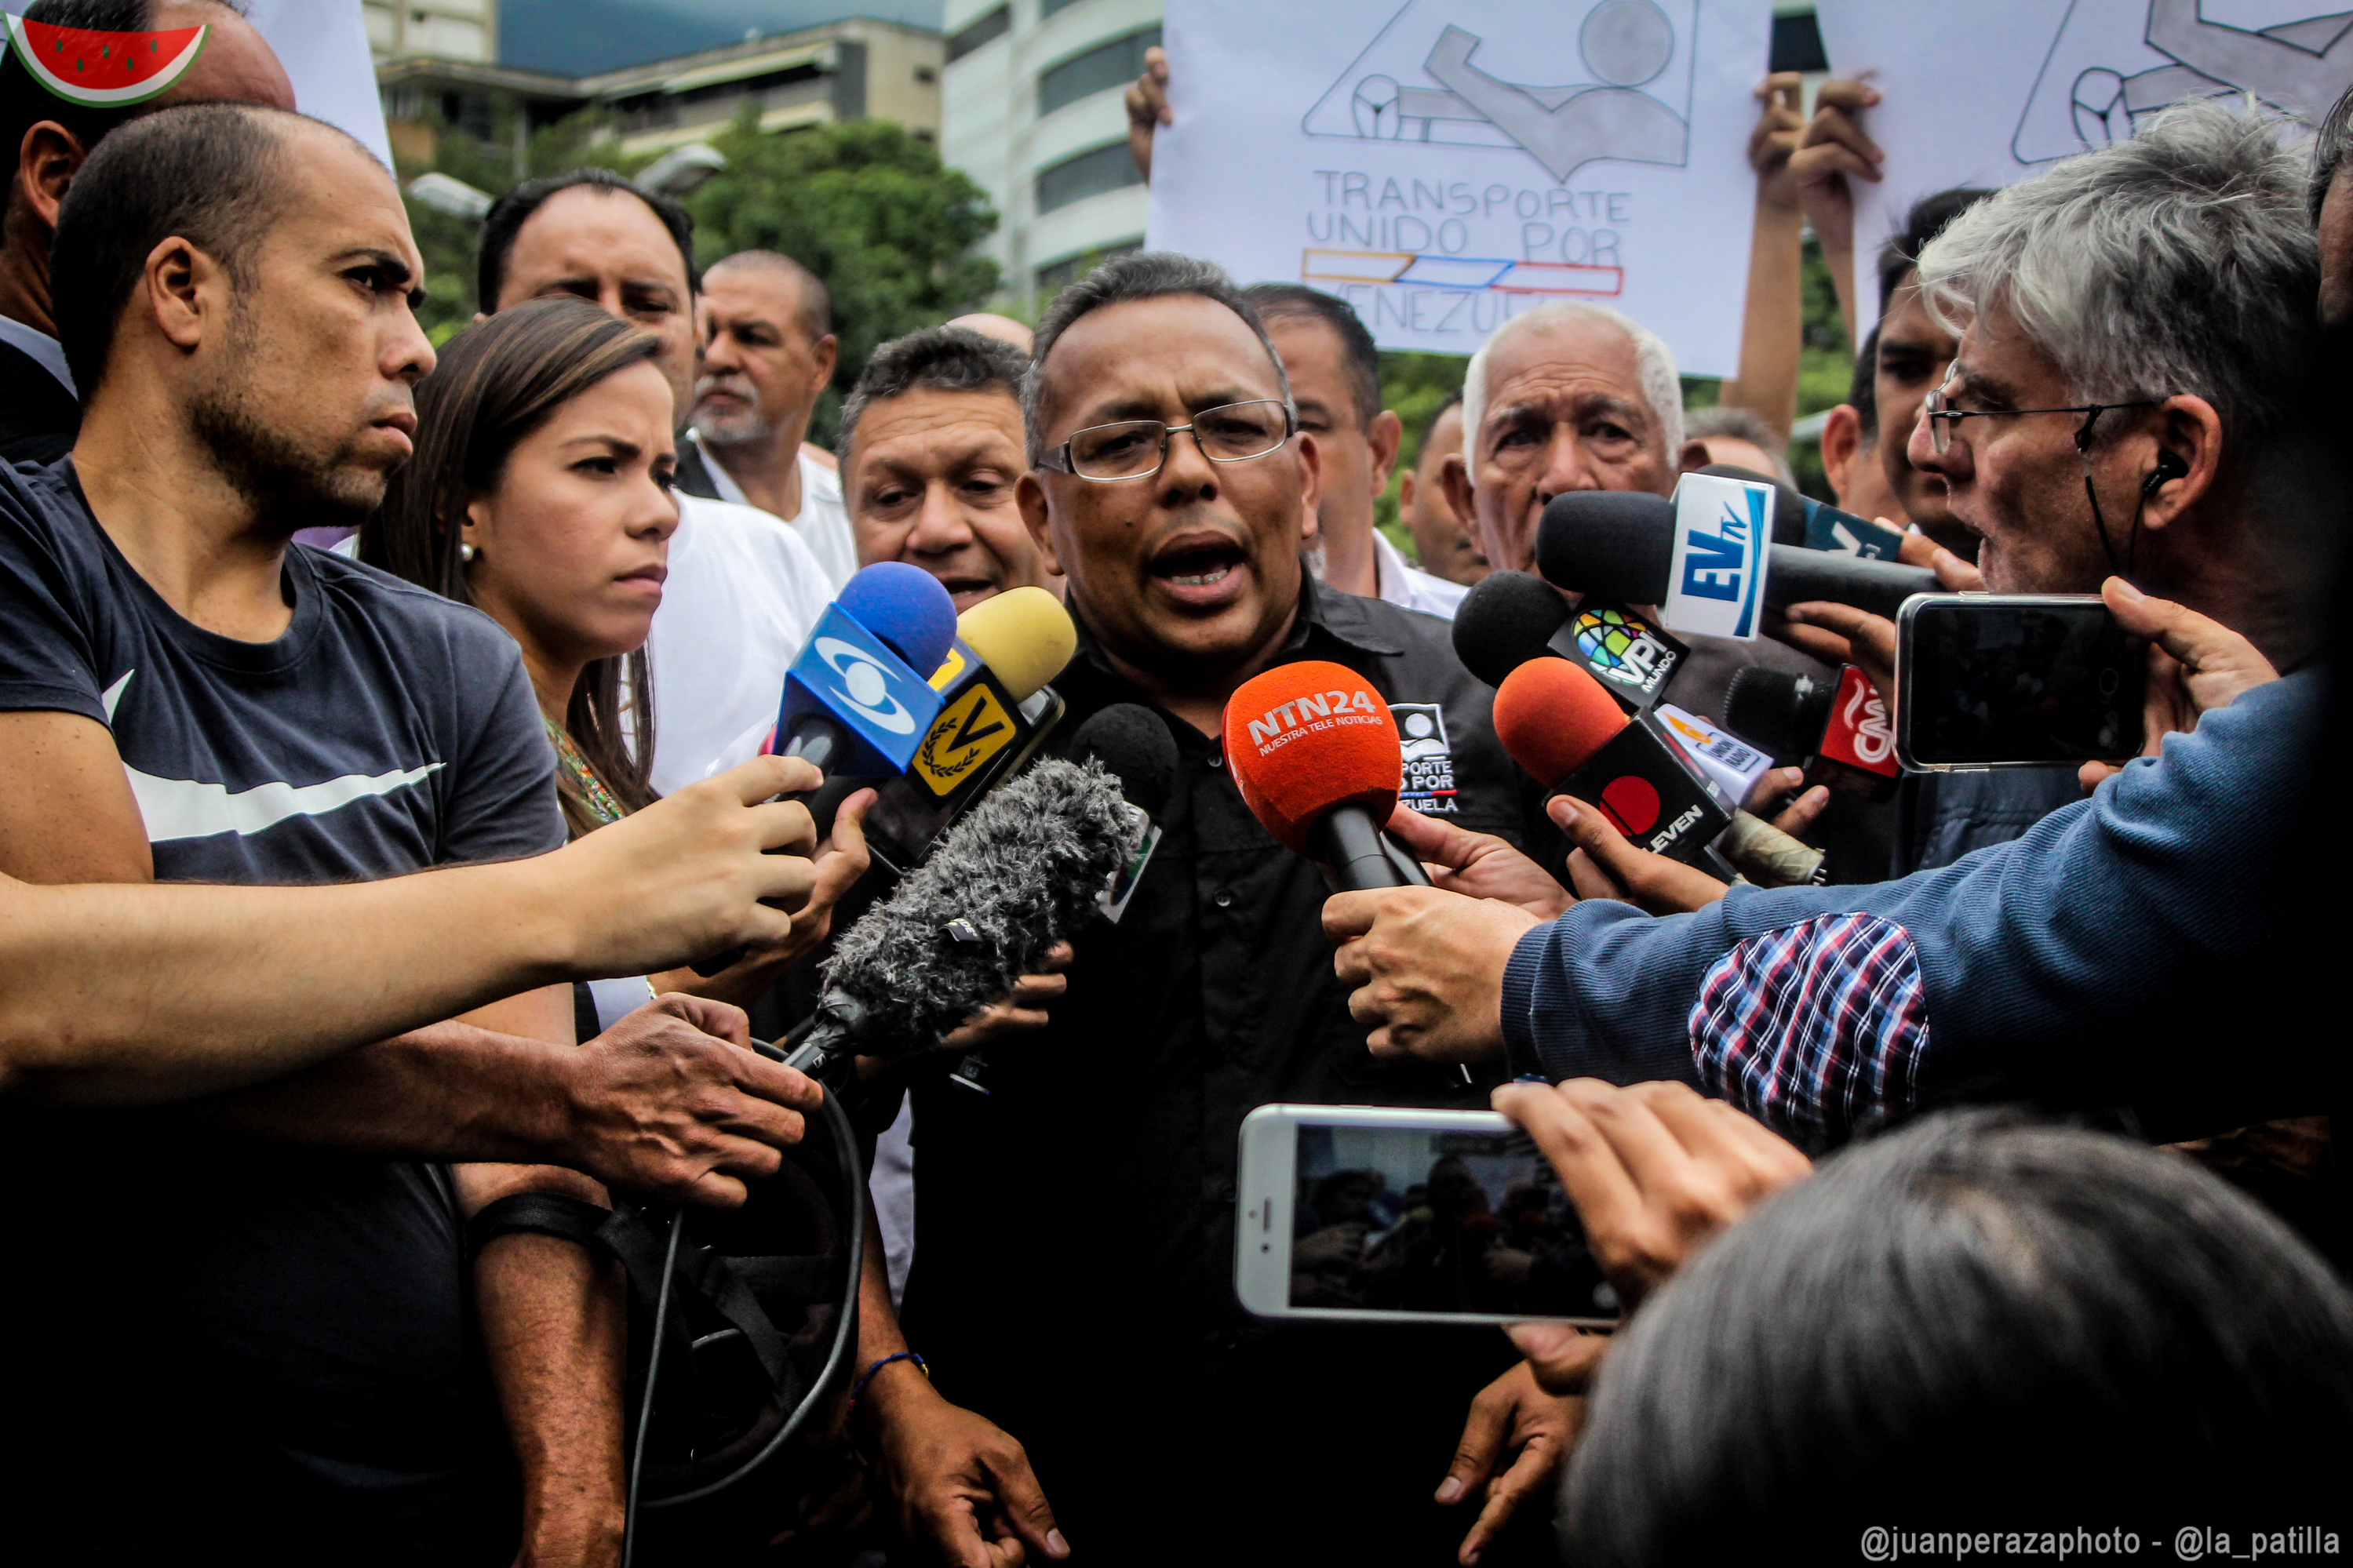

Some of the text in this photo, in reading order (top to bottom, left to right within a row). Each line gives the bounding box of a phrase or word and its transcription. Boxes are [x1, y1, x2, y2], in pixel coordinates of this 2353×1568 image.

[1312, 169, 1631, 223] TRANSPORTE
[1306, 211, 1620, 267] UNIDO POR
[1641, 650, 1676, 693] MUNDO
[1248, 690, 1375, 746] NTN24
[1258, 715, 1383, 756] NUESTRA TELE NOTICIAS
[1411, 774, 1455, 790] POR
[1643, 804, 1703, 854] EVEN
